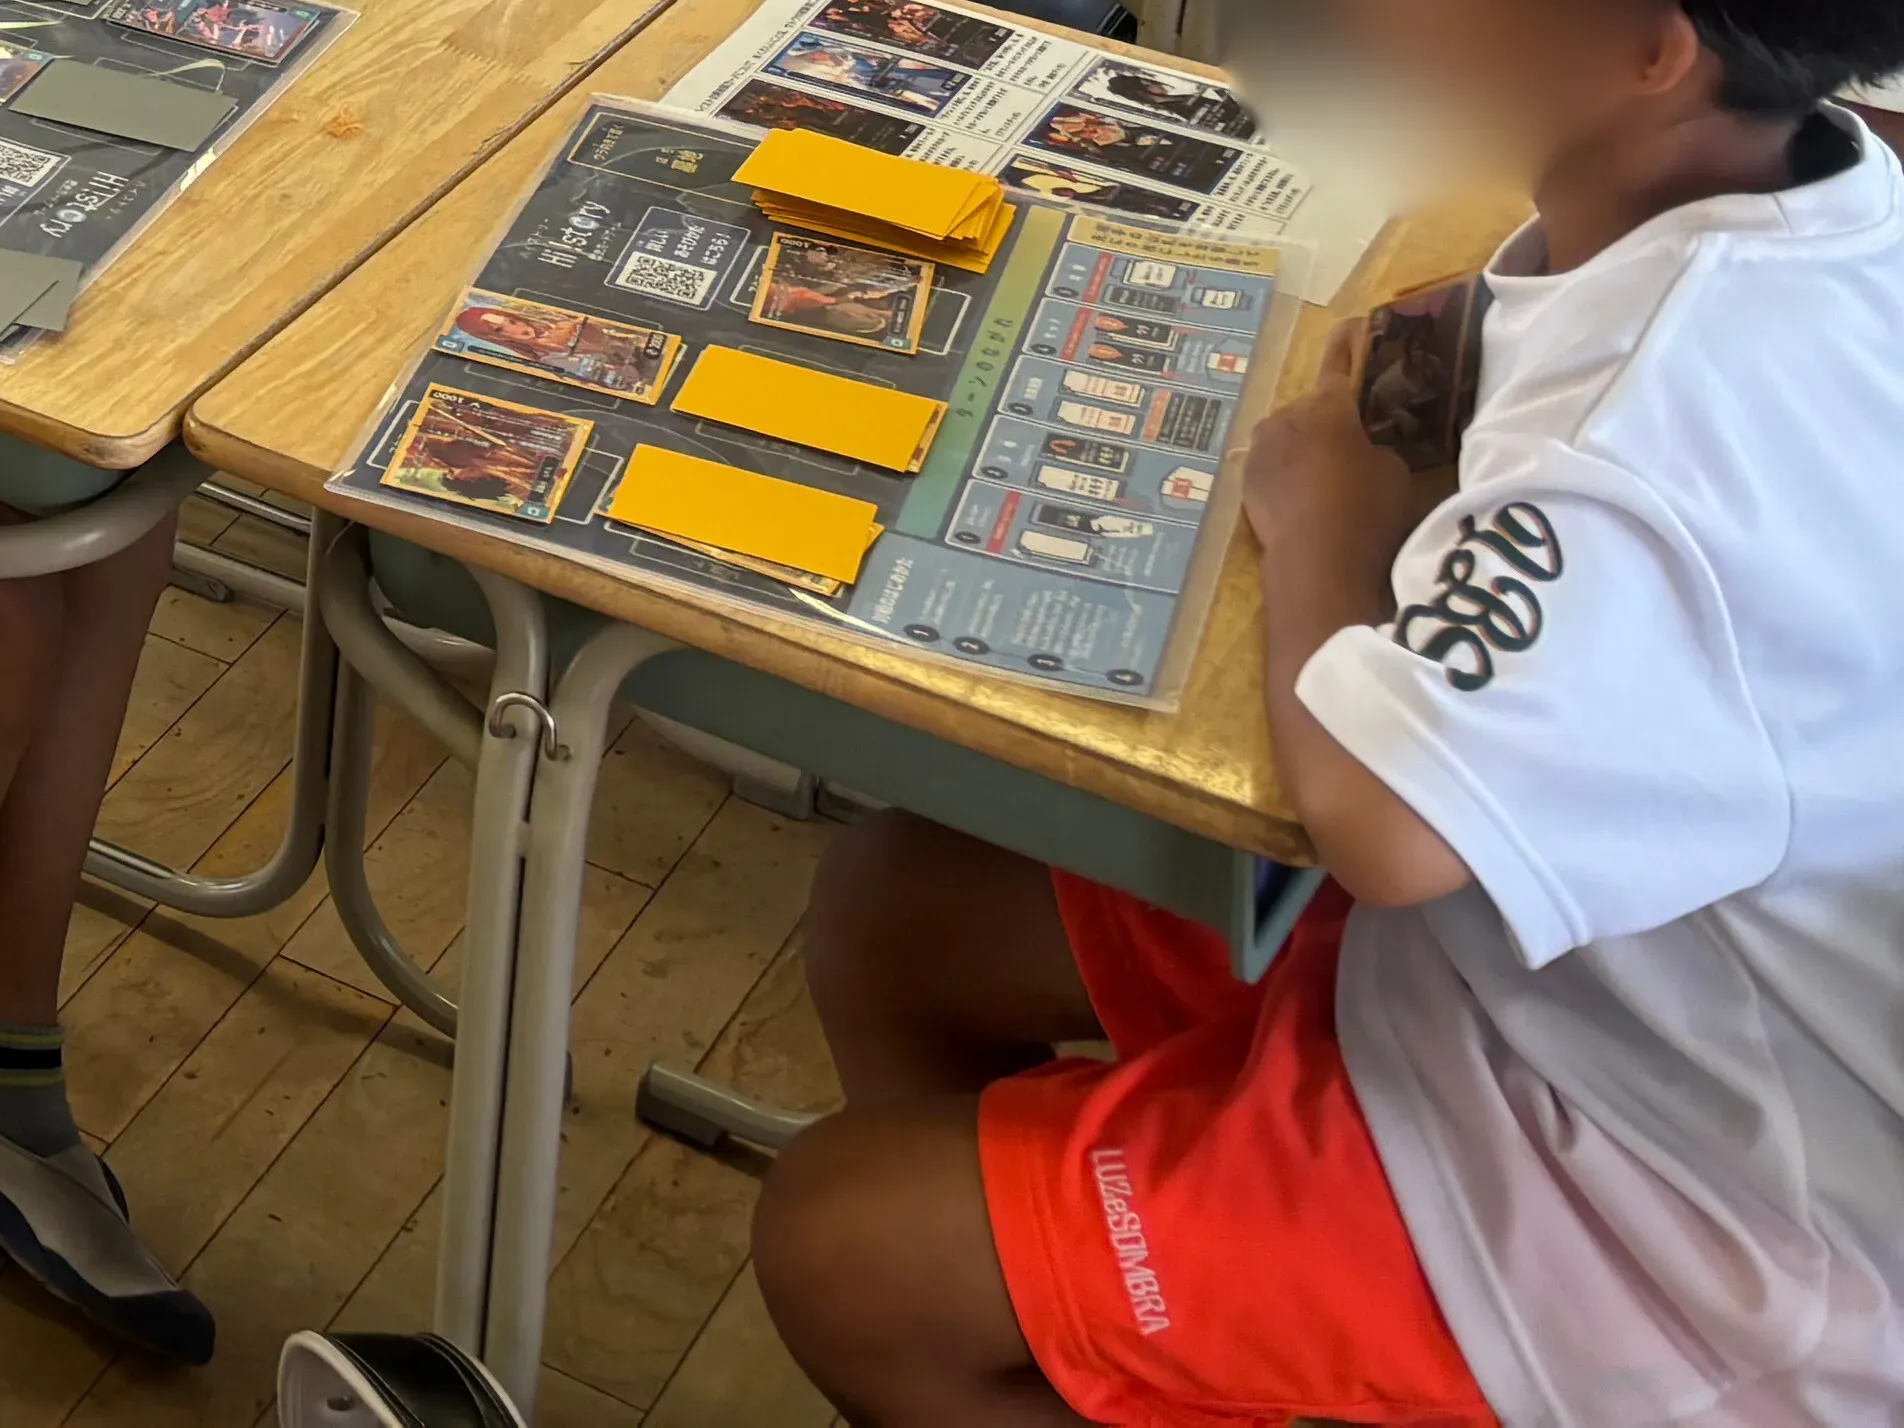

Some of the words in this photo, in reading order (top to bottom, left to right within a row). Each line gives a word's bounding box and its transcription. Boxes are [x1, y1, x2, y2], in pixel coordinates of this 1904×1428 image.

[672, 223, 706, 258] あそびかた
[1092, 1148, 1171, 1337] LUZeSOMBRA
